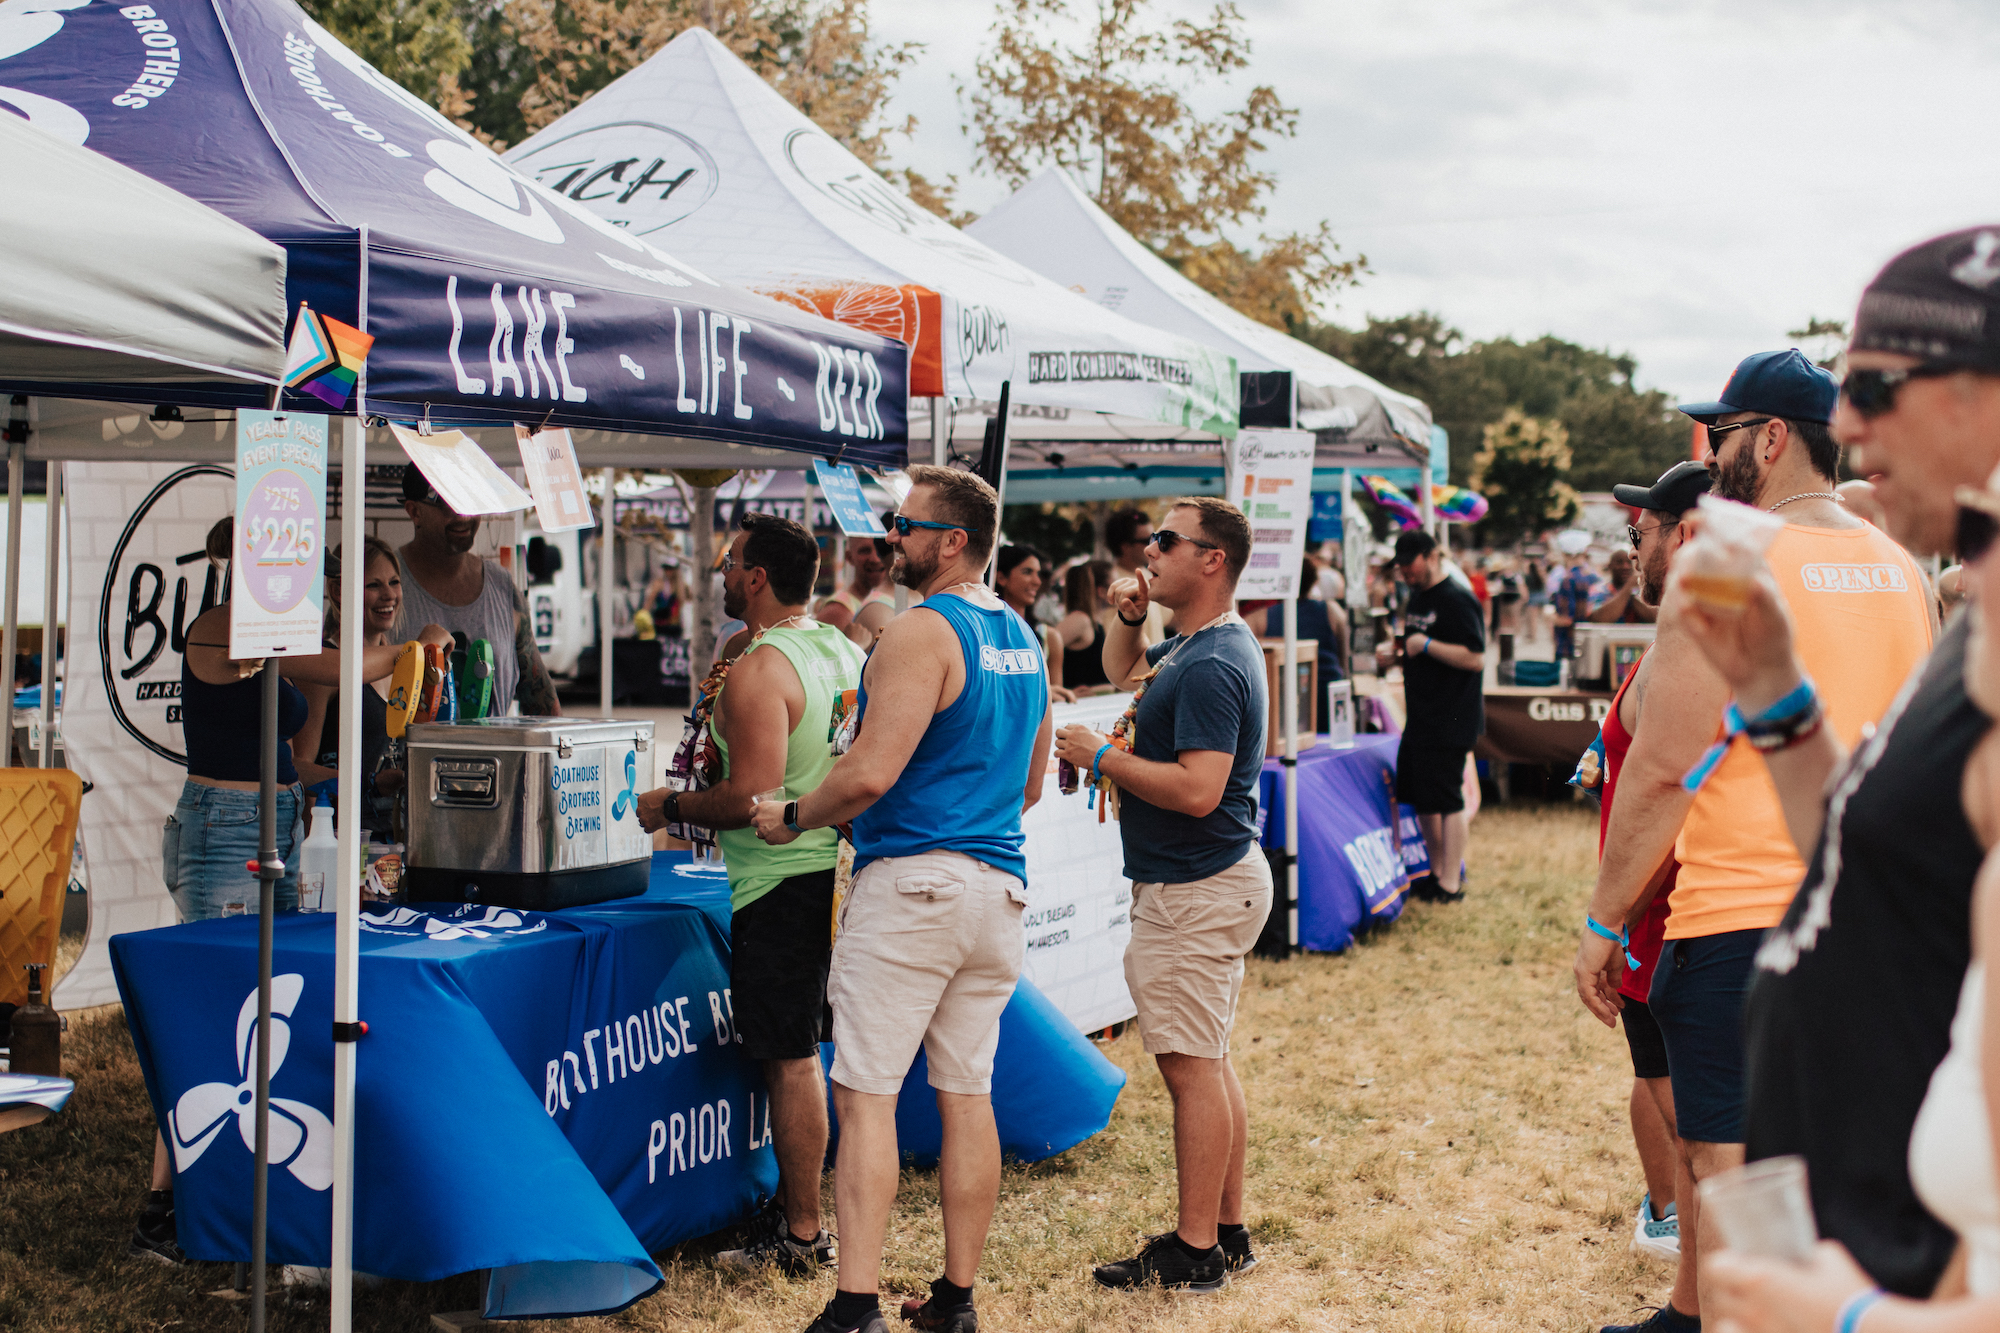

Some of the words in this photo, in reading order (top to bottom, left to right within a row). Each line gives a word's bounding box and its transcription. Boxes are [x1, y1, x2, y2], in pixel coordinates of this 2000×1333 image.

[112, 4, 181, 110] BROTHERS
[283, 31, 412, 158] BOATHOUSE
[447, 275, 588, 404] LAKE
[673, 306, 753, 420] LIFE
[809, 340, 885, 441] BEER
[1030, 353, 1067, 383] HARD
[1143, 354, 1192, 386] SELTZER
[246, 419, 292, 443] YEARLY
[294, 421, 323, 448] PASS
[243, 443, 279, 471] EVENT
[281, 443, 323, 474] SPECIAL
[264, 486, 300, 511] $275
[248, 514, 316, 564] $225
[1801, 563, 1908, 593] SPENCE
[137, 682, 182, 700] HARD
[1528, 697, 1585, 721] Gus
[551, 765, 600, 790] BOATHOUSE
[559, 791, 600, 815] BROTHERS
[566, 816, 601, 839] BREWING
[648, 1098, 731, 1184] PRIOR
